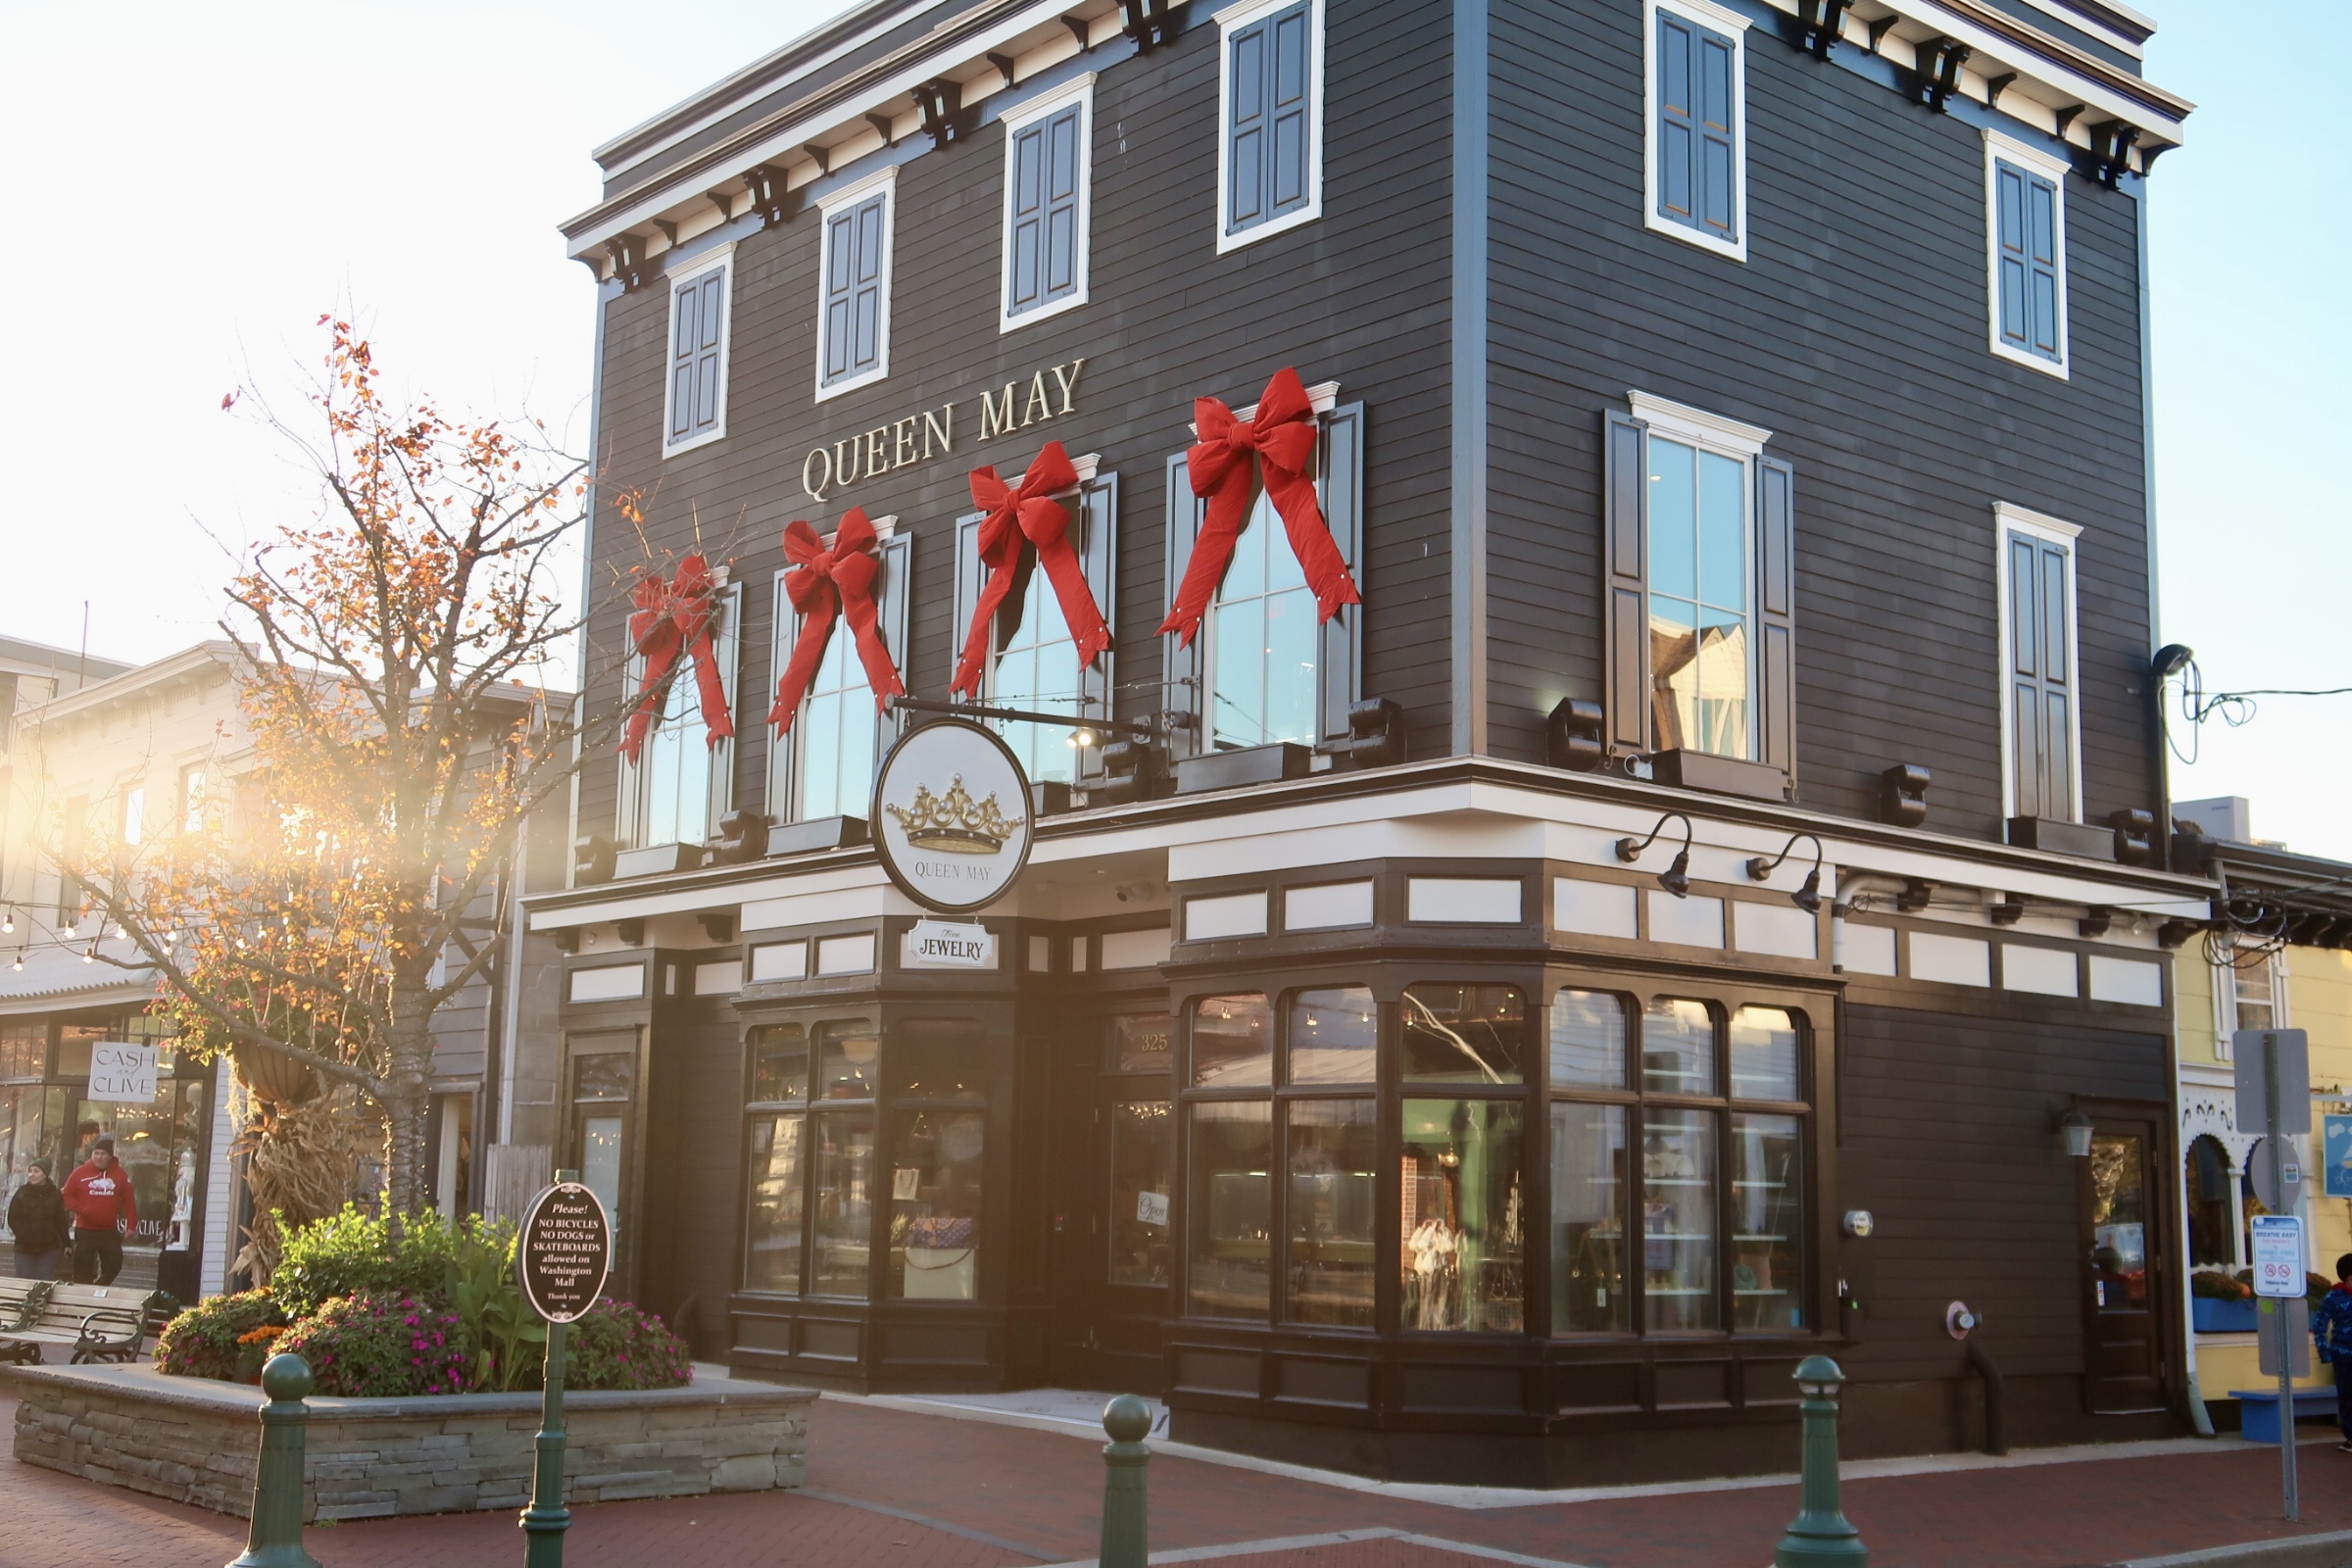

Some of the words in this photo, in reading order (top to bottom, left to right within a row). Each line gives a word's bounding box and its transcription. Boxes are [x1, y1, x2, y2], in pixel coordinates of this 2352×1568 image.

[803, 402, 955, 503] QUEEN
[977, 358, 1085, 442] MAY
[915, 861, 960, 879] QUEEN
[966, 865, 992, 881] MAY
[942, 929, 960, 939] Fine
[919, 939, 984, 960] JEWELRY
[1141, 1034, 1167, 1052] 325
[96, 1050, 156, 1068] CASH
[117, 1067, 140, 1078] and
[93, 1076, 154, 1096] CLIVE
[552, 1203, 588, 1214] Please!
[1139, 1196, 1165, 1220] Open
[539, 1219, 554, 1228] NO
[556, 1220, 599, 1229] BICYCLES
[540, 1231, 555, 1240] NO
[557, 1231, 583, 1241] DOGS
[533, 1243, 601, 1252] SKATEBOARDS
[542, 1254, 576, 1263] allowed
[539, 1266, 592, 1277] Washington
[555, 1278, 574, 1287] Mall
